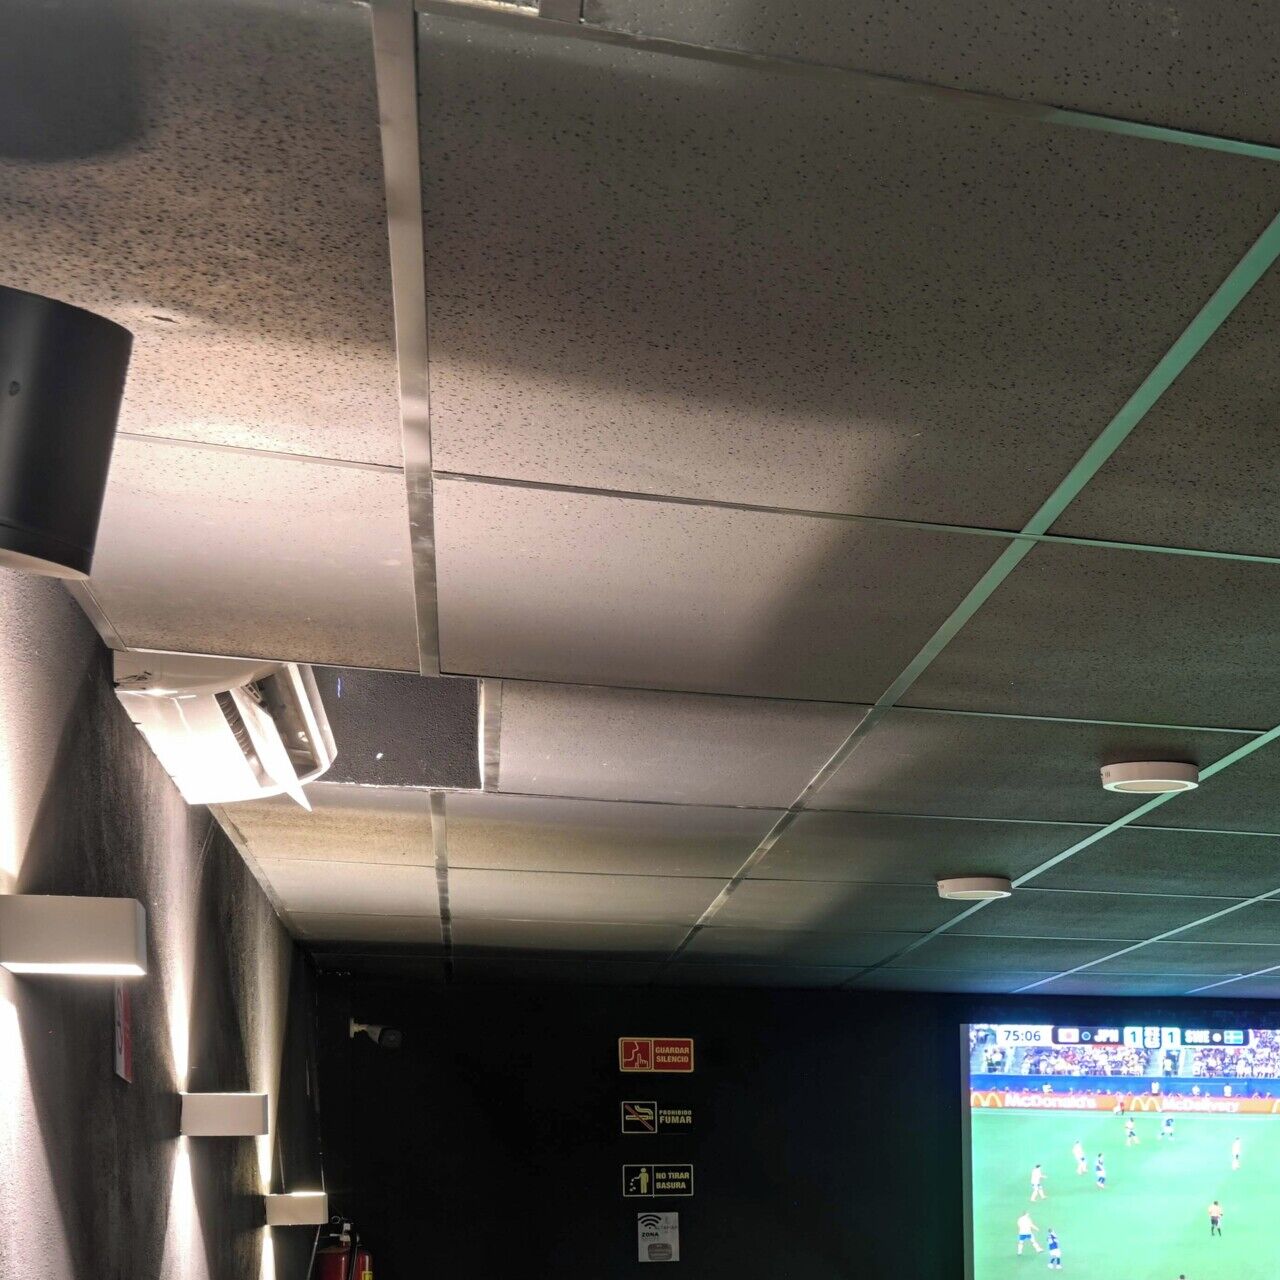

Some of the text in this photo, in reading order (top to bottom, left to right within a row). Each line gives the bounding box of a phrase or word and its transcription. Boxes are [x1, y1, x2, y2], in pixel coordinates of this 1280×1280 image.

[1004, 1030, 1042, 1042] 75:06
[1093, 1029, 1120, 1043] JPN
[1130, 1031, 1138, 1042] 1
[1167, 1031, 1175, 1042] 1
[1184, 1029, 1211, 1044] SWE
[655, 1046, 690, 1054] GUARDAR
[656, 1055, 689, 1063] SILENCIO
[1005, 1093, 1097, 1108] McDonald's
[659, 1115, 692, 1124] FUMAR
[655, 1172, 667, 1180] NO
[656, 1181, 687, 1189] BASURA
